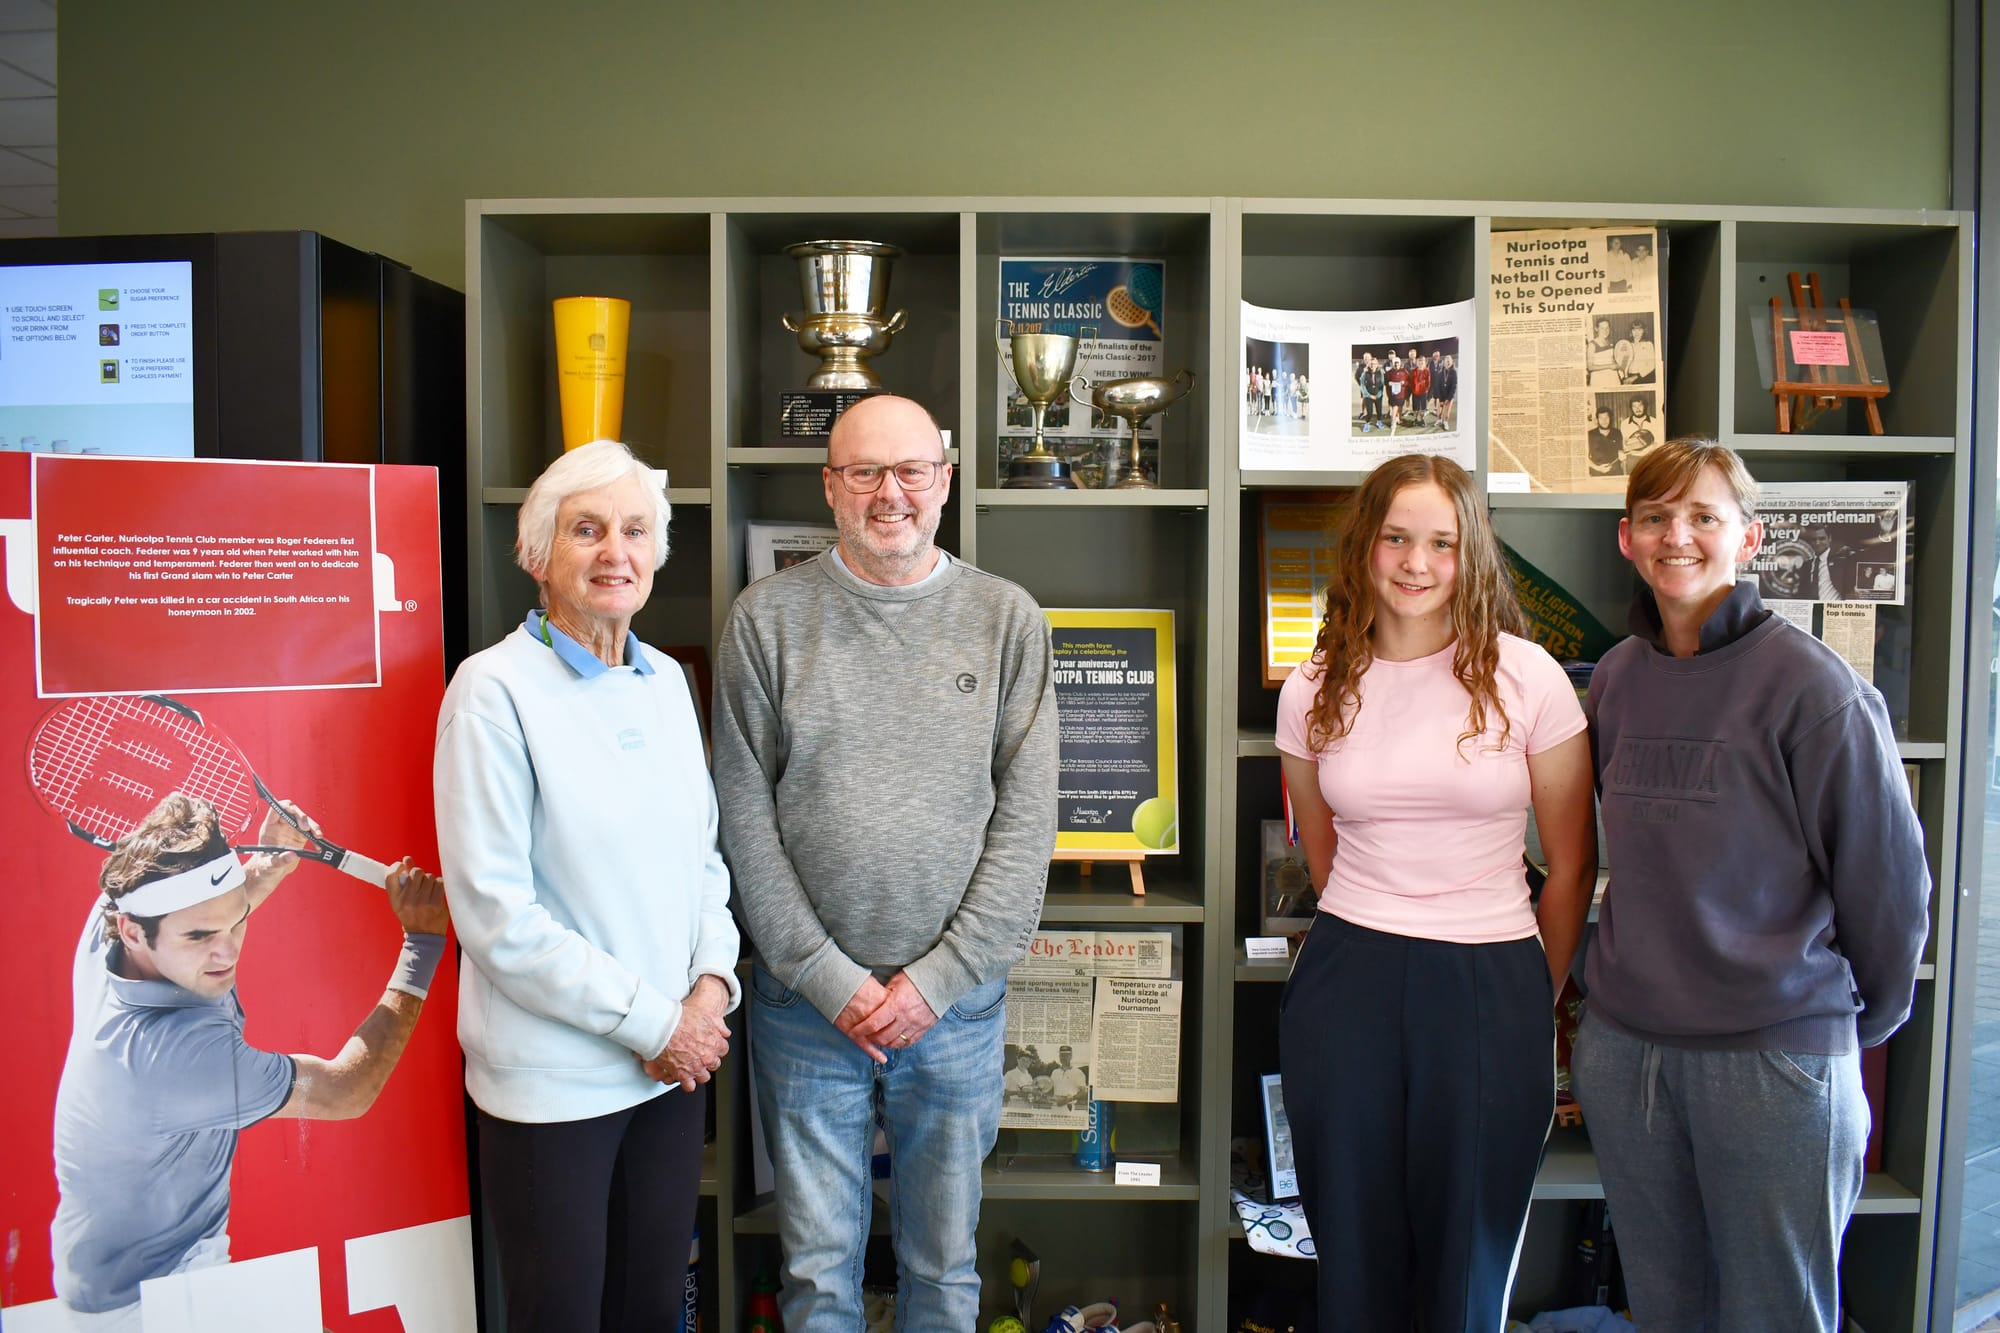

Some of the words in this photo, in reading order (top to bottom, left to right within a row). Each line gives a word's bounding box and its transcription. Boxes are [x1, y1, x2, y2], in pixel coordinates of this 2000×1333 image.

[1507, 239, 1587, 253] Nuriootpa
[1505, 255, 1555, 268] Tennis
[1560, 252, 1589, 265] and
[1490, 270, 1550, 284] Netball
[1555, 268, 1606, 281] Courts
[1008, 282, 1030, 298] THE
[1495, 289, 1510, 299] to
[1517, 287, 1536, 298] be
[1540, 282, 1602, 299] Opened
[1008, 303, 1050, 319] TENNIS
[1053, 304, 1102, 319] CLASSIC
[1503, 302, 1532, 314] This
[1538, 300, 1595, 314] Sunday
[1098, 342, 1128, 351] finalists
[1130, 343, 1138, 351] of
[1139, 343, 1152, 352] the
[1080, 353, 1104, 361] Tennis
[1106, 352, 1131, 362] Classic
[1137, 354, 1156, 362] 2017
[1866, 500, 1896, 509] champion
[1789, 513, 1797, 523] a
[1800, 510, 1876, 526] gentleman
[58, 534, 82, 543] Peter
[84, 535, 116, 544] Carter,
[119, 535, 164, 544] Nuriootpa
[166, 536, 193, 544] Tennis
[196, 536, 216, 544] Club
[276, 537, 301, 546] Roger
[1770, 528, 1800, 542] very
[53, 546, 98, 555] influential
[101, 547, 134, 556] coach.
[136, 548, 170, 556] Federer
[193, 548, 198, 556] 9
[226, 548, 240, 556] old
[292, 549, 323, 557] worked
[325, 549, 342, 557] with
[69, 560, 81, 568] his
[84, 560, 130, 568] technique
[133, 560, 151, 568] and
[154, 560, 216, 569] temperament.
[219, 560, 252, 568] Federer
[254, 560, 274, 568] then
[1752, 558, 1778, 571] him
[129, 572, 141, 580] his
[144, 572, 159, 580] first
[161, 572, 190, 580] Grand
[192, 572, 213, 580] slam
[215, 572, 230, 580] win
[232, 572, 241, 580] to
[243, 572, 265, 580] Peter
[266, 572, 294, 580] Carter
[66, 596, 112, 606] Tragically
[114, 596, 138, 604] Peter
[160, 596, 185, 604] killed
[187, 596, 195, 604] in
[222, 596, 262, 604] accident
[264, 596, 272, 604] in
[274, 596, 298, 604] South
[300, 595, 324, 604] Africa
[338, 595, 350, 603] his
[168, 608, 222, 617] honeymoon
[224, 608, 232, 616] in
[234, 608, 256, 616] 2002.
[1060, 661, 1076, 670] year
[1078, 660, 1120, 670] anniversary
[1121, 660, 1128, 668] of
[1086, 670, 1124, 684] TENNIS
[1127, 670, 1155, 684] CLUB
[1030, 938, 1062, 958] The
[1066, 939, 1136, 959] Leader
[1109, 980, 1157, 990] Temperature
[1138, 989, 1159, 997] sizzle
[1121, 996, 1159, 1005] Nuriootpa
[1118, 1004, 1161, 1012] tournament
[685, 1272, 698, 1333] zenger
